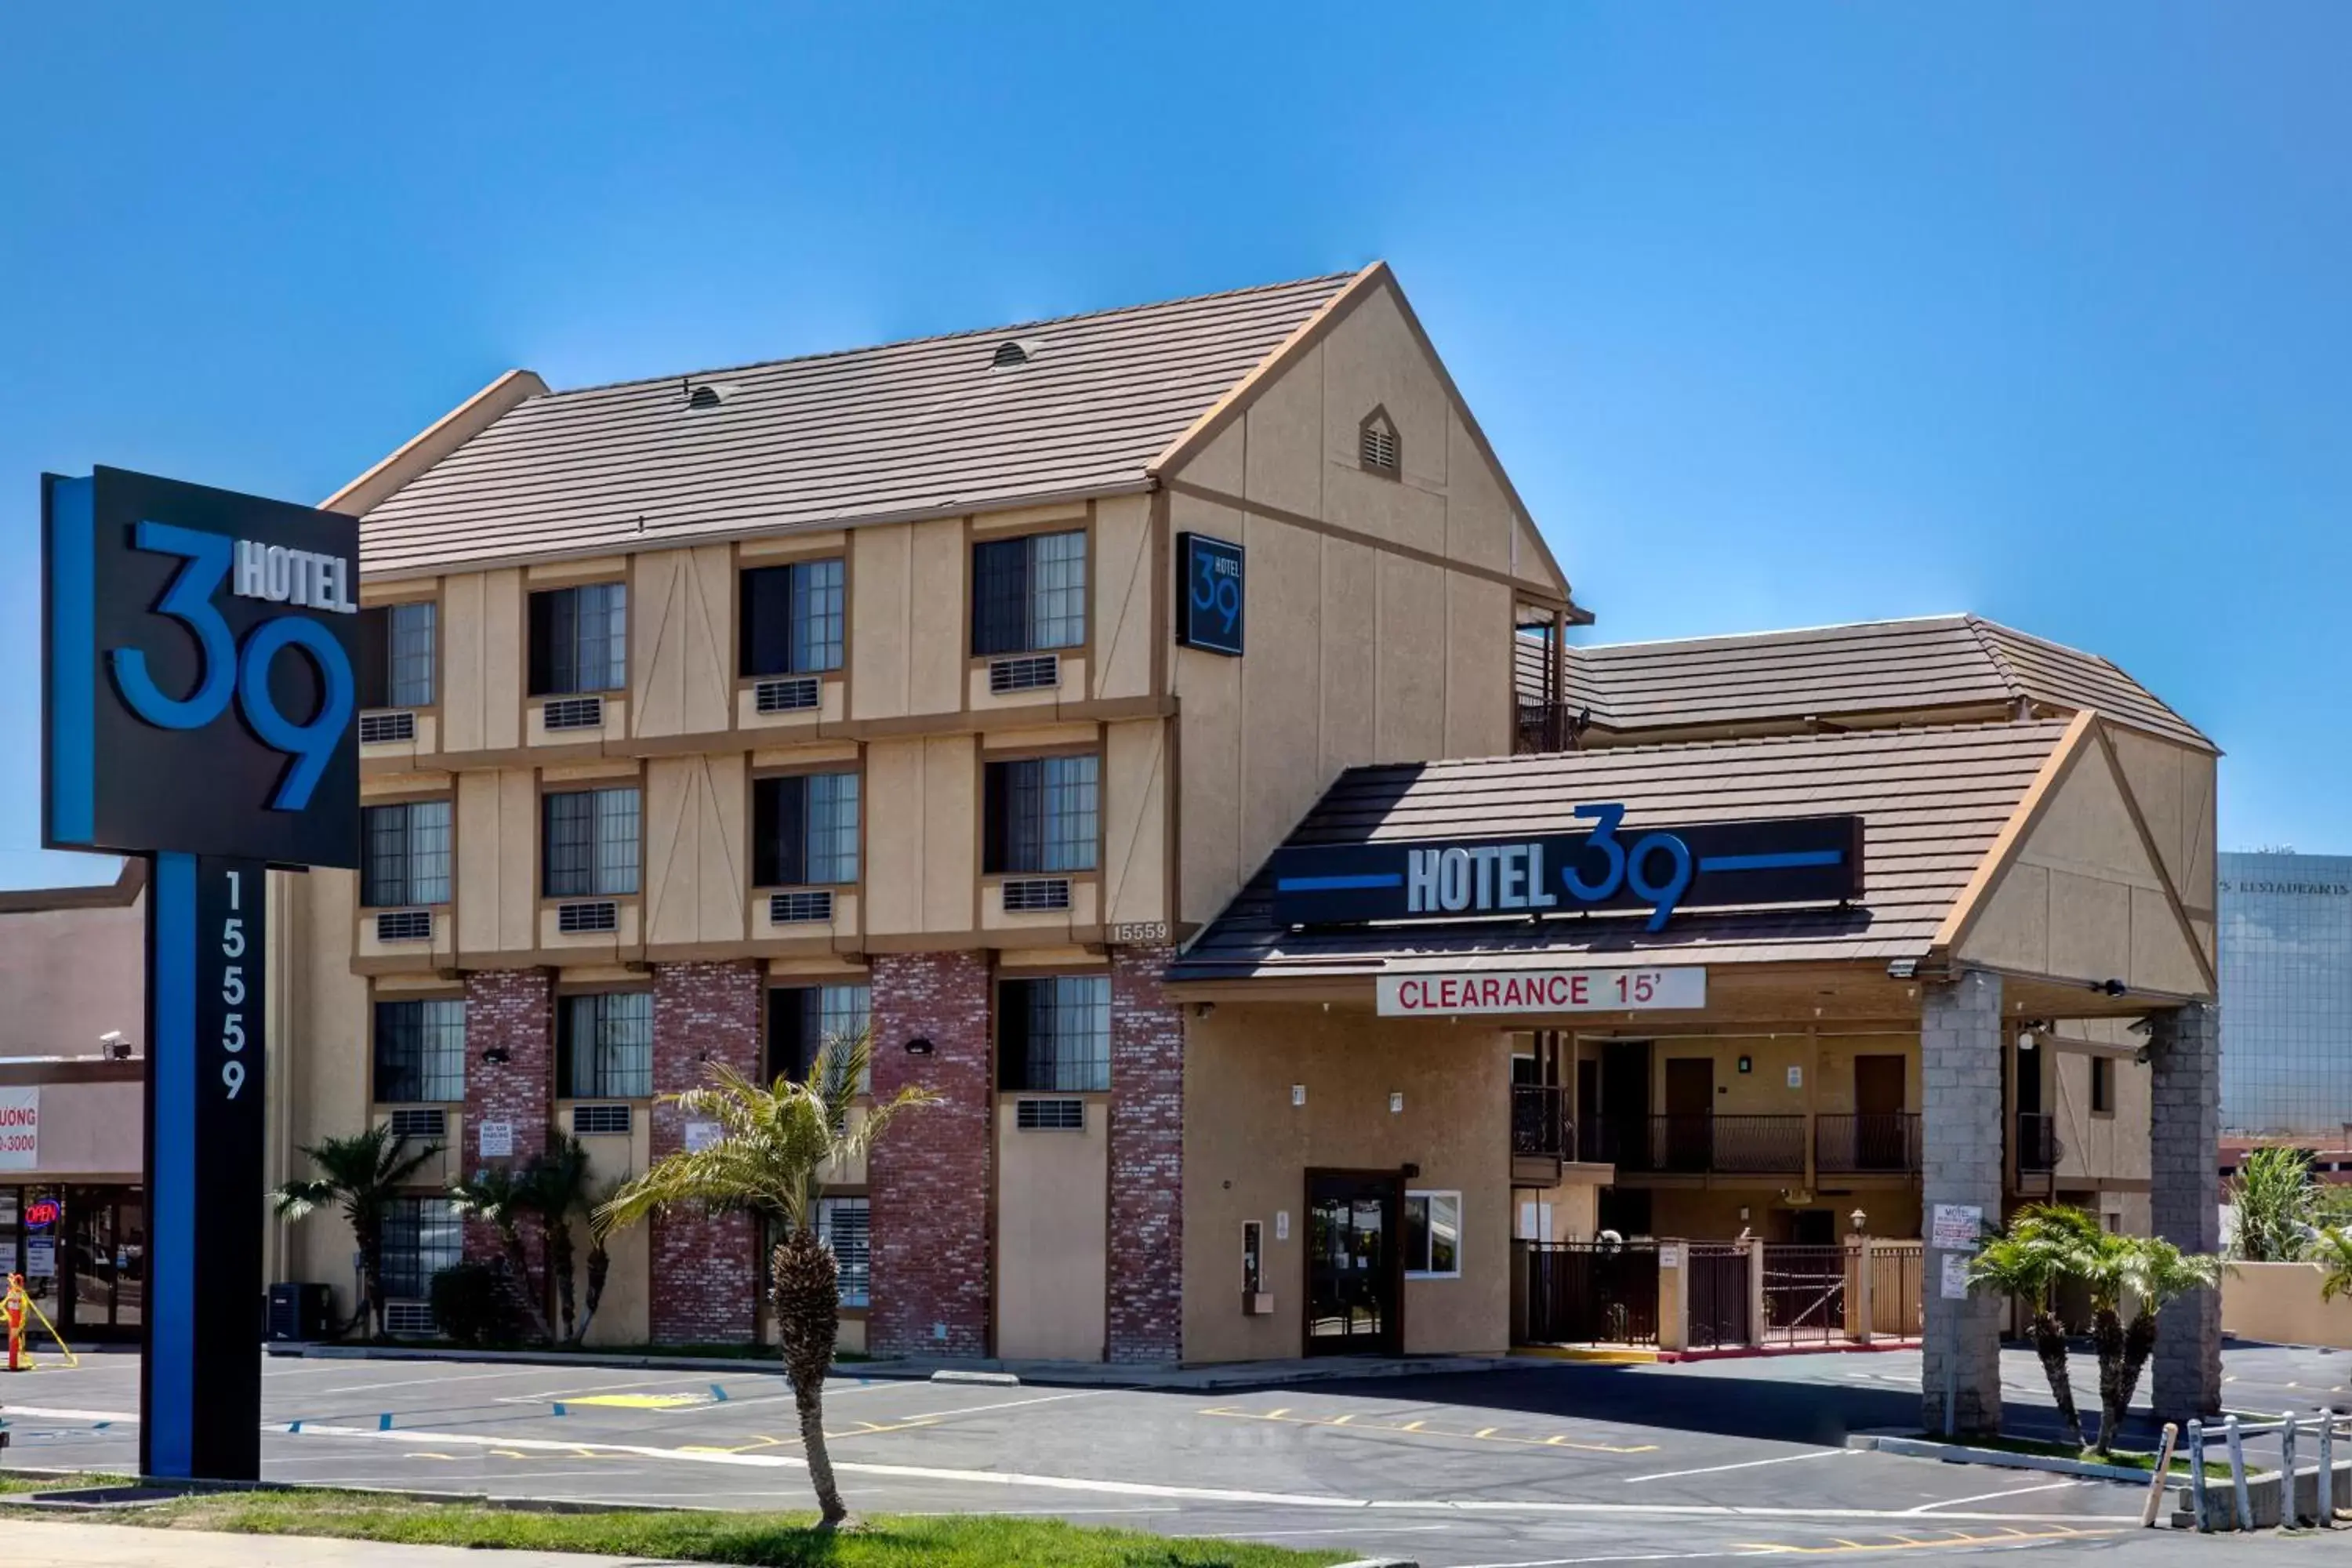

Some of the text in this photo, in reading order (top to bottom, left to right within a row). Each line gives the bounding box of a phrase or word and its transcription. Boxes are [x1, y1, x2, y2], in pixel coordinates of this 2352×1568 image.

[234, 539, 357, 614] HOTEL
[1192, 552, 1239, 634] 39
[1215, 557, 1239, 577] HOTEL
[114, 520, 354, 811] 39
[1408, 803, 1692, 933] HOTEL 39
[1115, 924, 1167, 941] 15559
[222, 871, 245, 1099] 15559
[1399, 973, 1662, 1009] CLEARANCE 15'
[26, 1203, 56, 1223] OPEN
